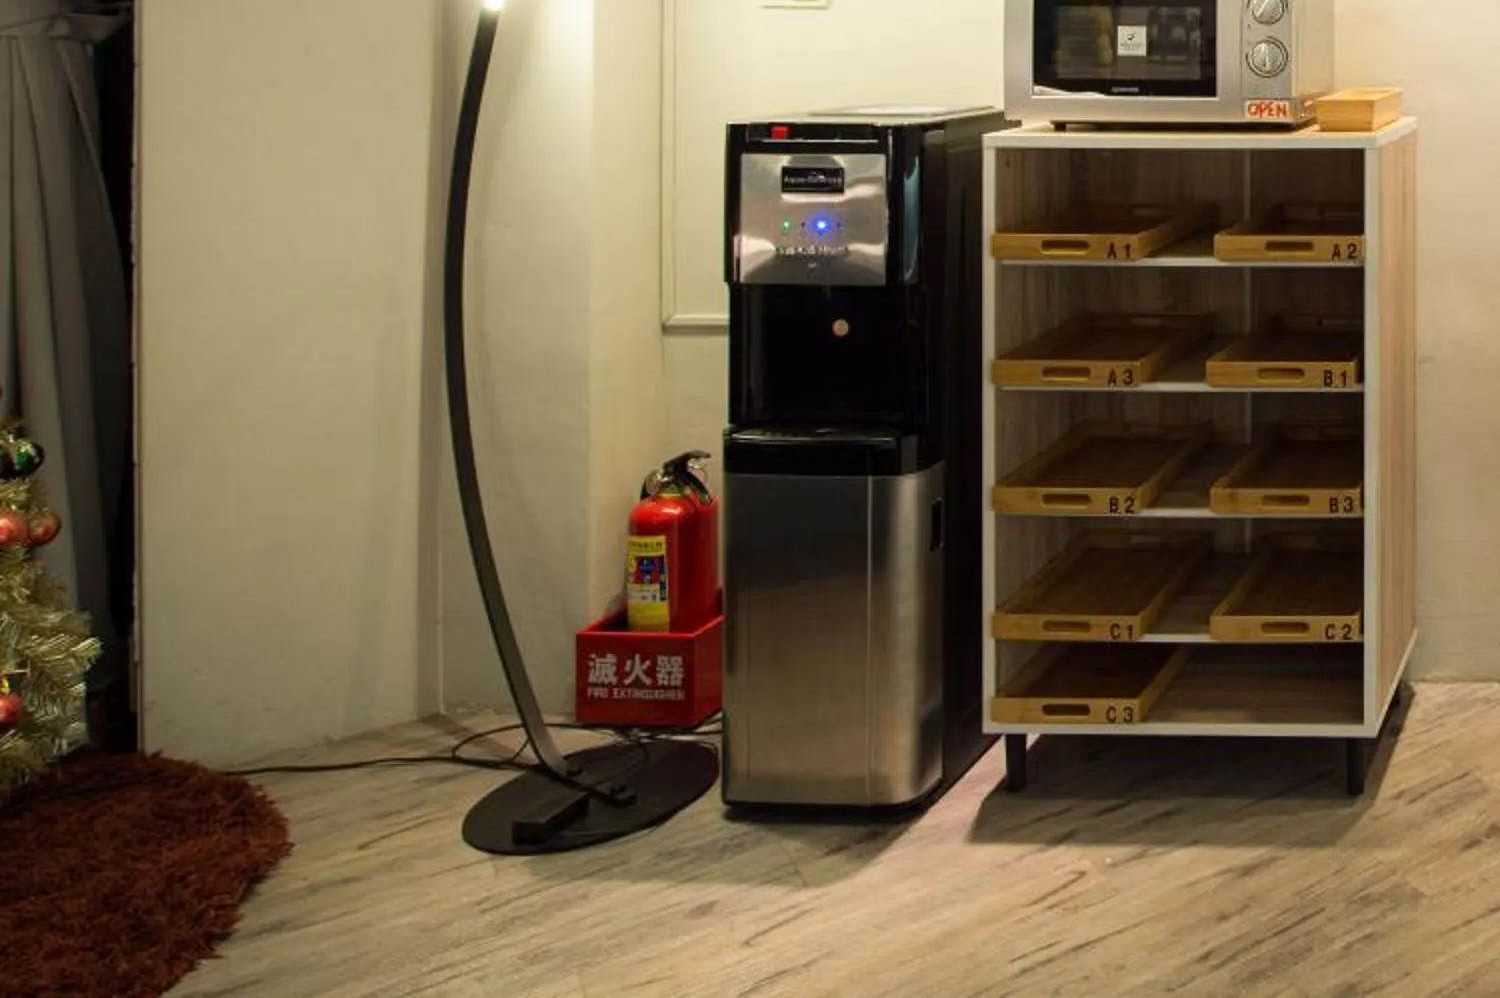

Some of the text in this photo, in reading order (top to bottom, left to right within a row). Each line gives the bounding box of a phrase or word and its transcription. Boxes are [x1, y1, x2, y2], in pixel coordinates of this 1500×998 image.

[1247, 99, 1287, 117] OPEN
[587, 653, 684, 686] 滅火器
